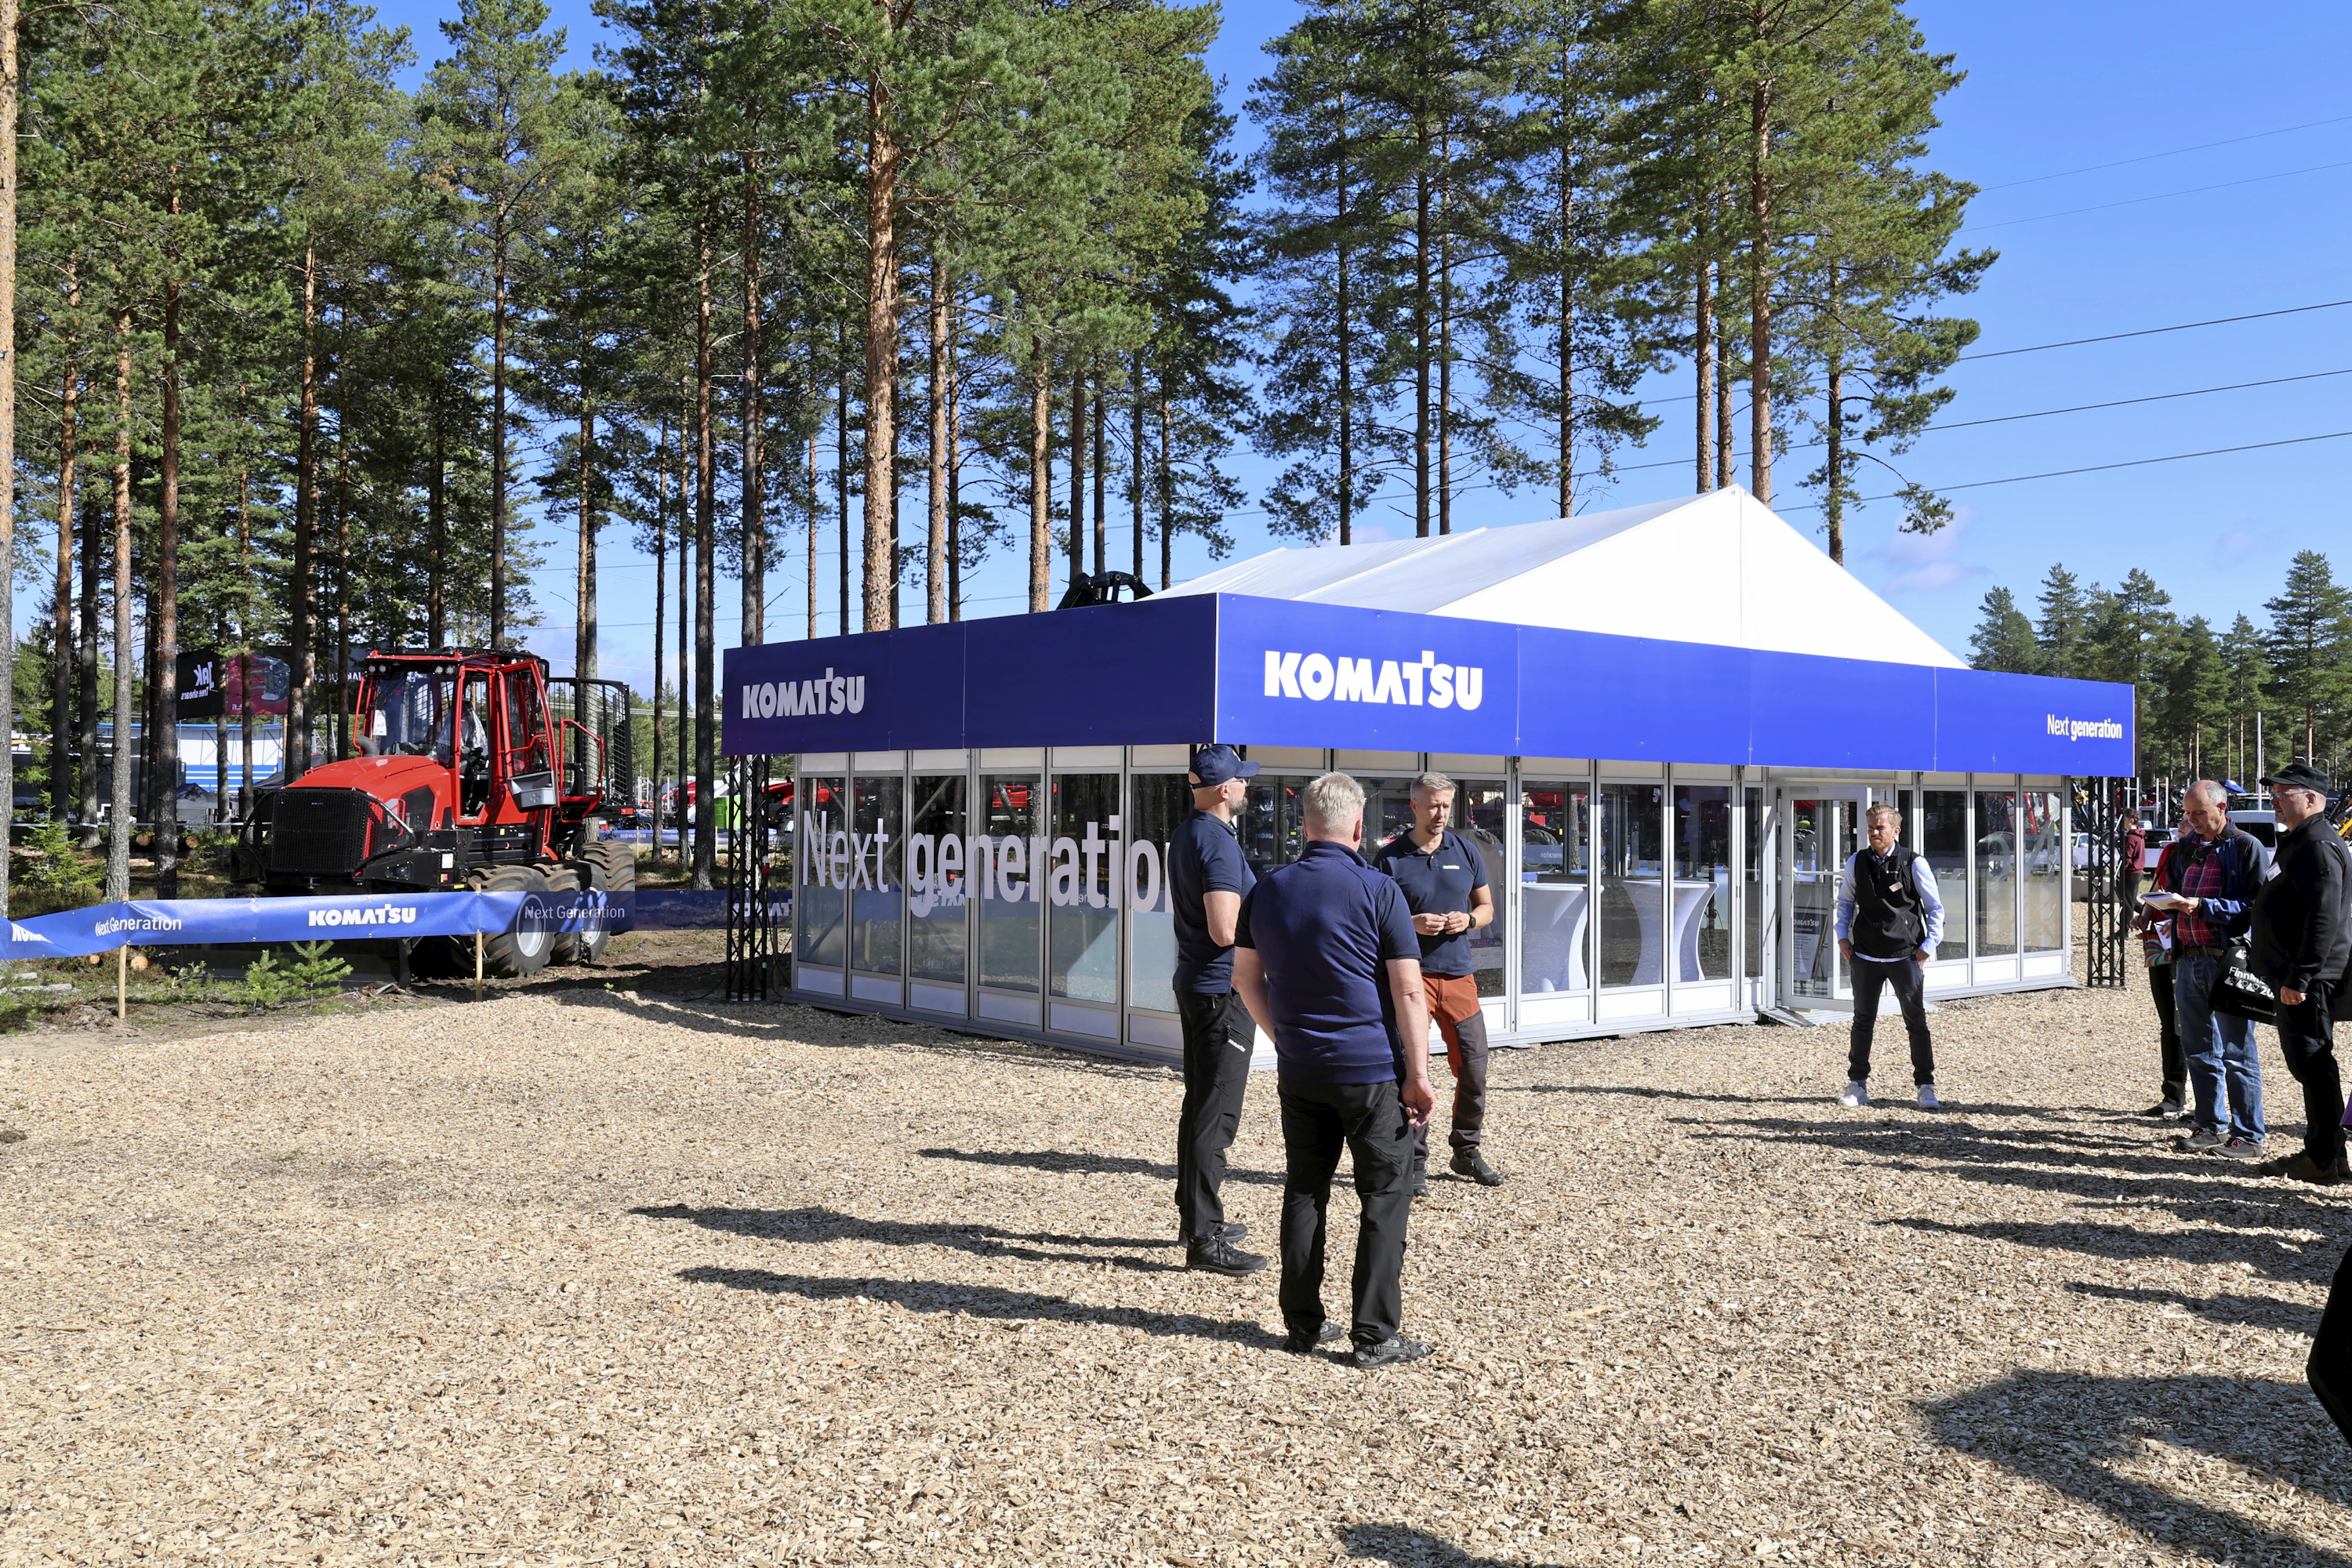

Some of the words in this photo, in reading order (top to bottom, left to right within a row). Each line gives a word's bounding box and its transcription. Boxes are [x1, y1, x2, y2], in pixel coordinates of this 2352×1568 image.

[742, 667, 865, 719] KOMATSU
[1264, 650, 1483, 711] KOMATSU
[2047, 713, 2070, 736] Next
[2071, 718, 2122, 742] generation
[803, 810, 889, 893] Next
[308, 903, 417, 927] KOMATSU
[524, 905, 554, 920] Next
[557, 905, 626, 920] Generation
[1793, 918, 1820, 927] OMATSU
[95, 920, 111, 938] Next
[110, 916, 183, 934] Generation
